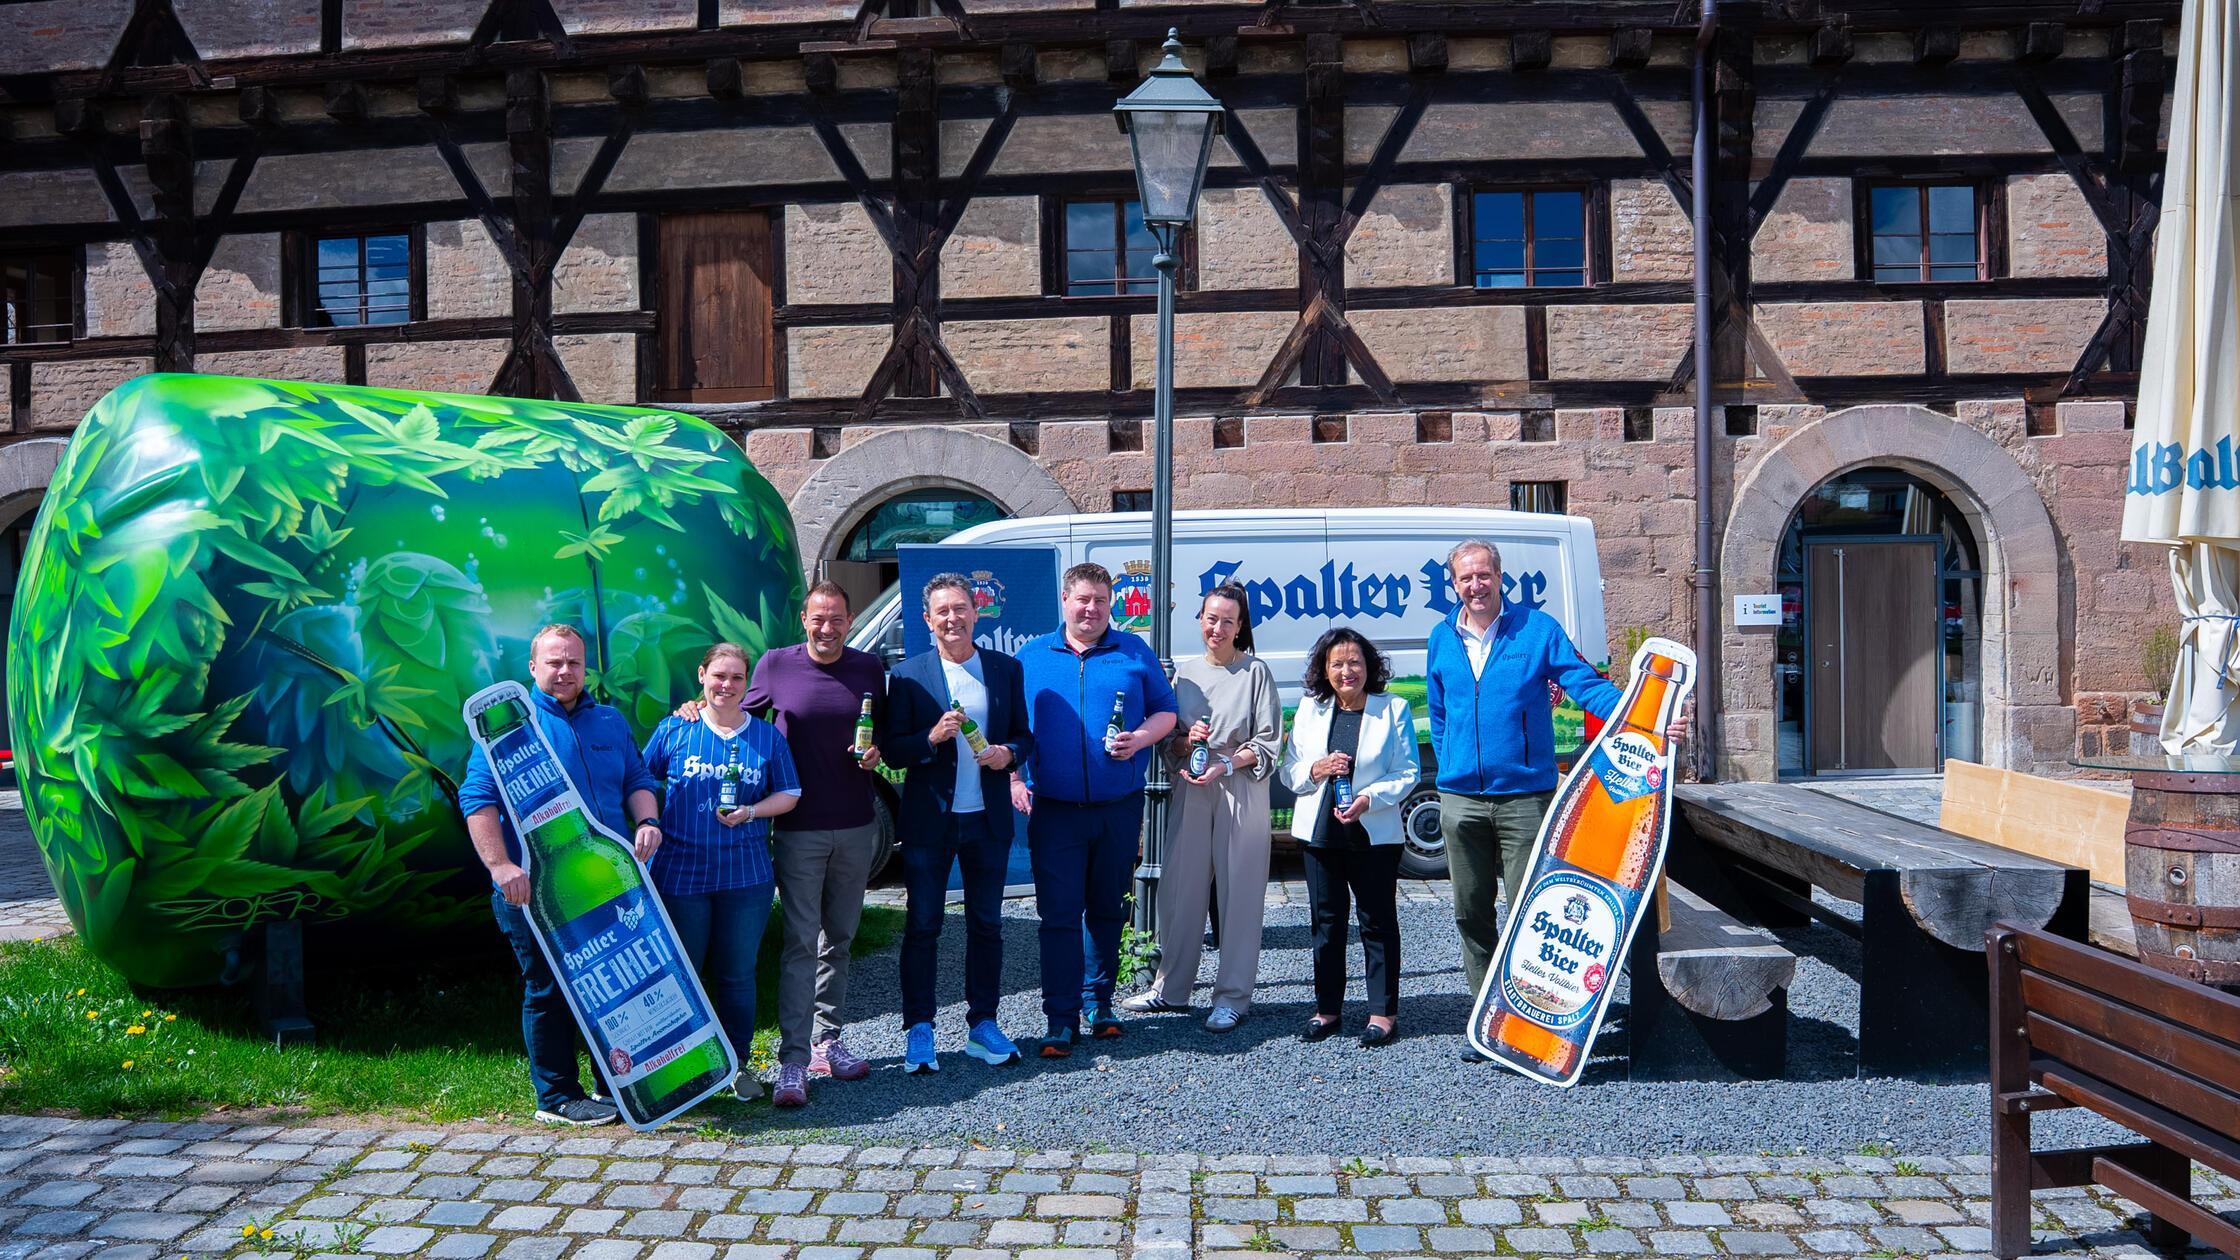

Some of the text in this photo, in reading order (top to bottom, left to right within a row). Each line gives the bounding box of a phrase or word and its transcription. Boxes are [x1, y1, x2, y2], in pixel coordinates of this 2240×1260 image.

[496, 741, 543, 774] Spalter
[1611, 737, 1656, 763] Spalter
[1618, 754, 1642, 771] Bier
[682, 755, 762, 787] Spater
[563, 930, 618, 970] Spalter
[1530, 910, 1604, 959] Spalter
[571, 928, 673, 1014] FREIHEIT
[1538, 942, 1579, 975] Bier
[1521, 959, 1546, 979] Helles
[1548, 972, 1580, 994] Vollbier
[643, 993, 655, 1008] 40
[1504, 979, 1580, 1025] STADTBRAUEREI SPALT
[605, 1016, 619, 1031] 100
[644, 1043, 686, 1073] Alkoholfrei
